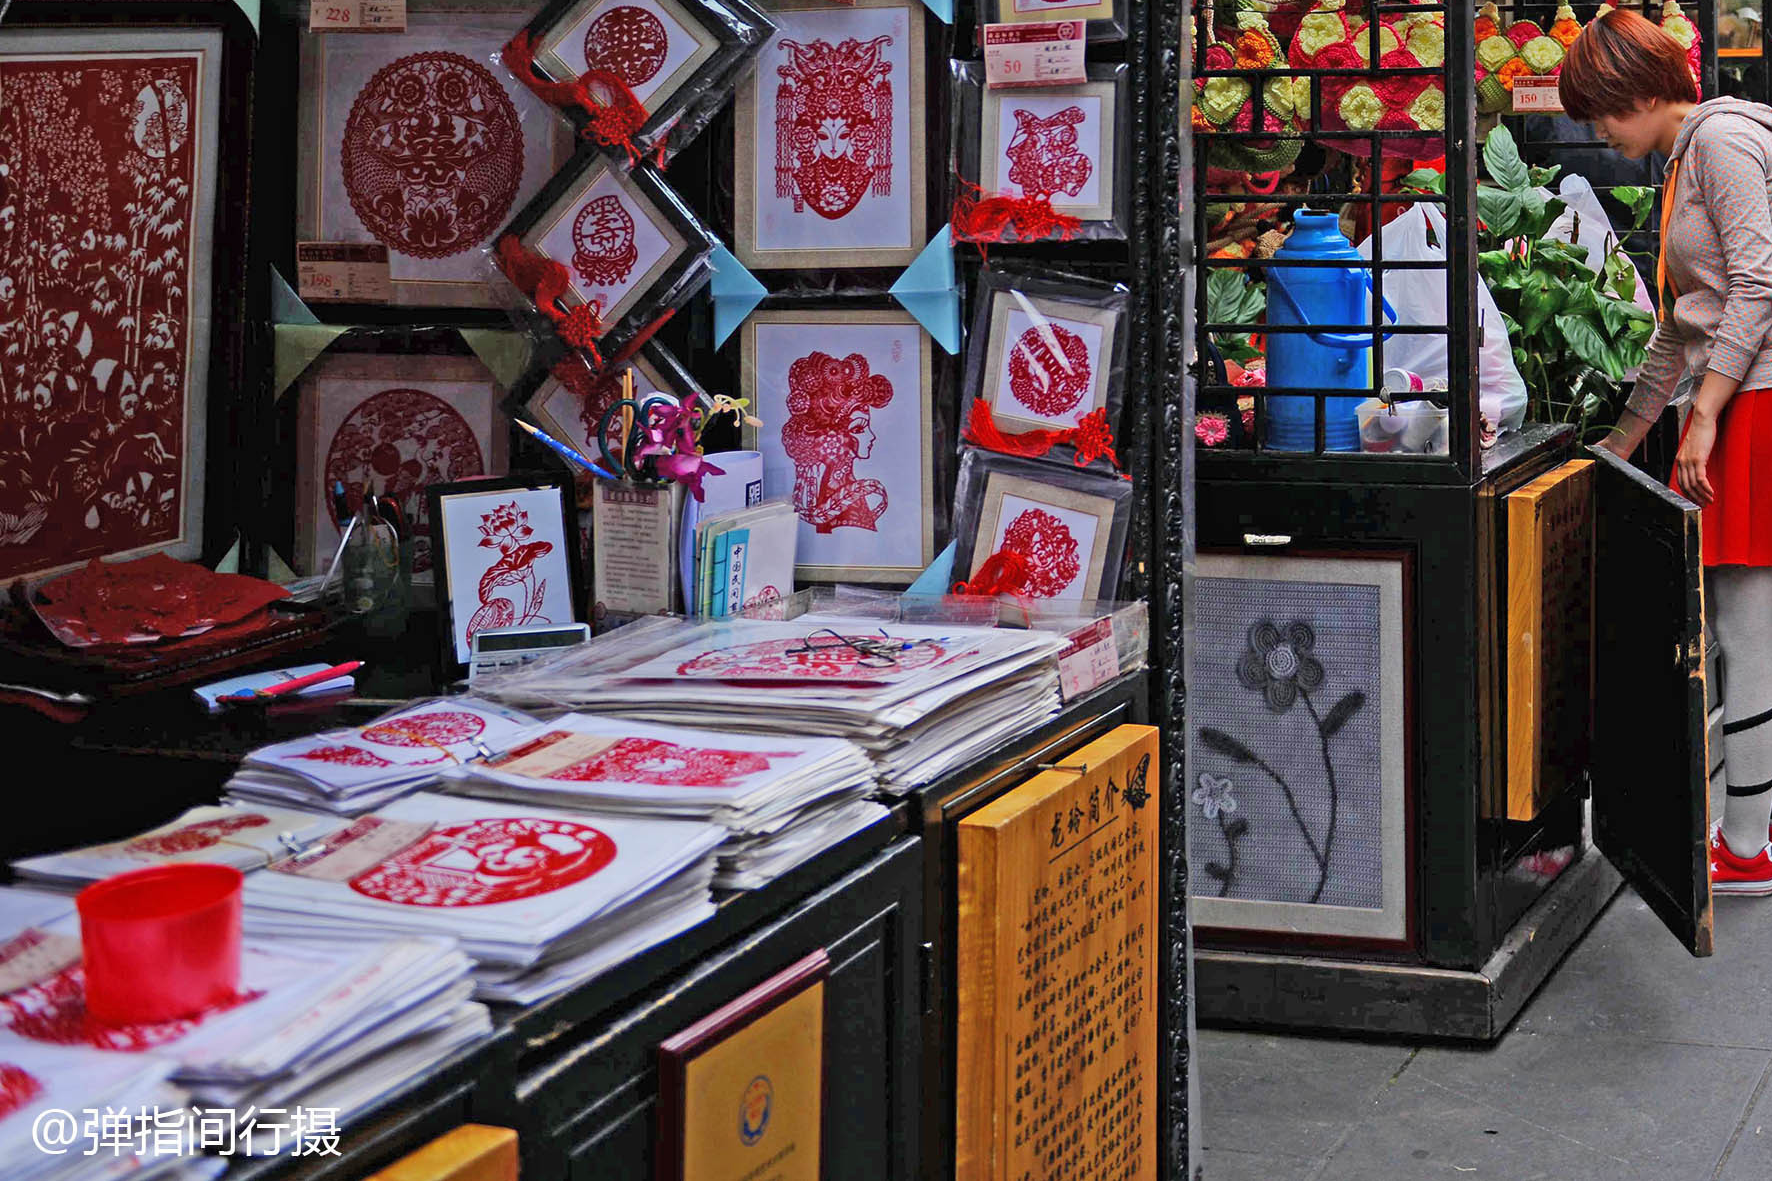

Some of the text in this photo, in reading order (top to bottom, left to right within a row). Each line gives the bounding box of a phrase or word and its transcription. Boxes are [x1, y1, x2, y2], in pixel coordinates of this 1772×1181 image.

[327, 8, 350, 22] 228
[1003, 59, 1022, 74] 50
[1520, 94, 1537, 103] 150
